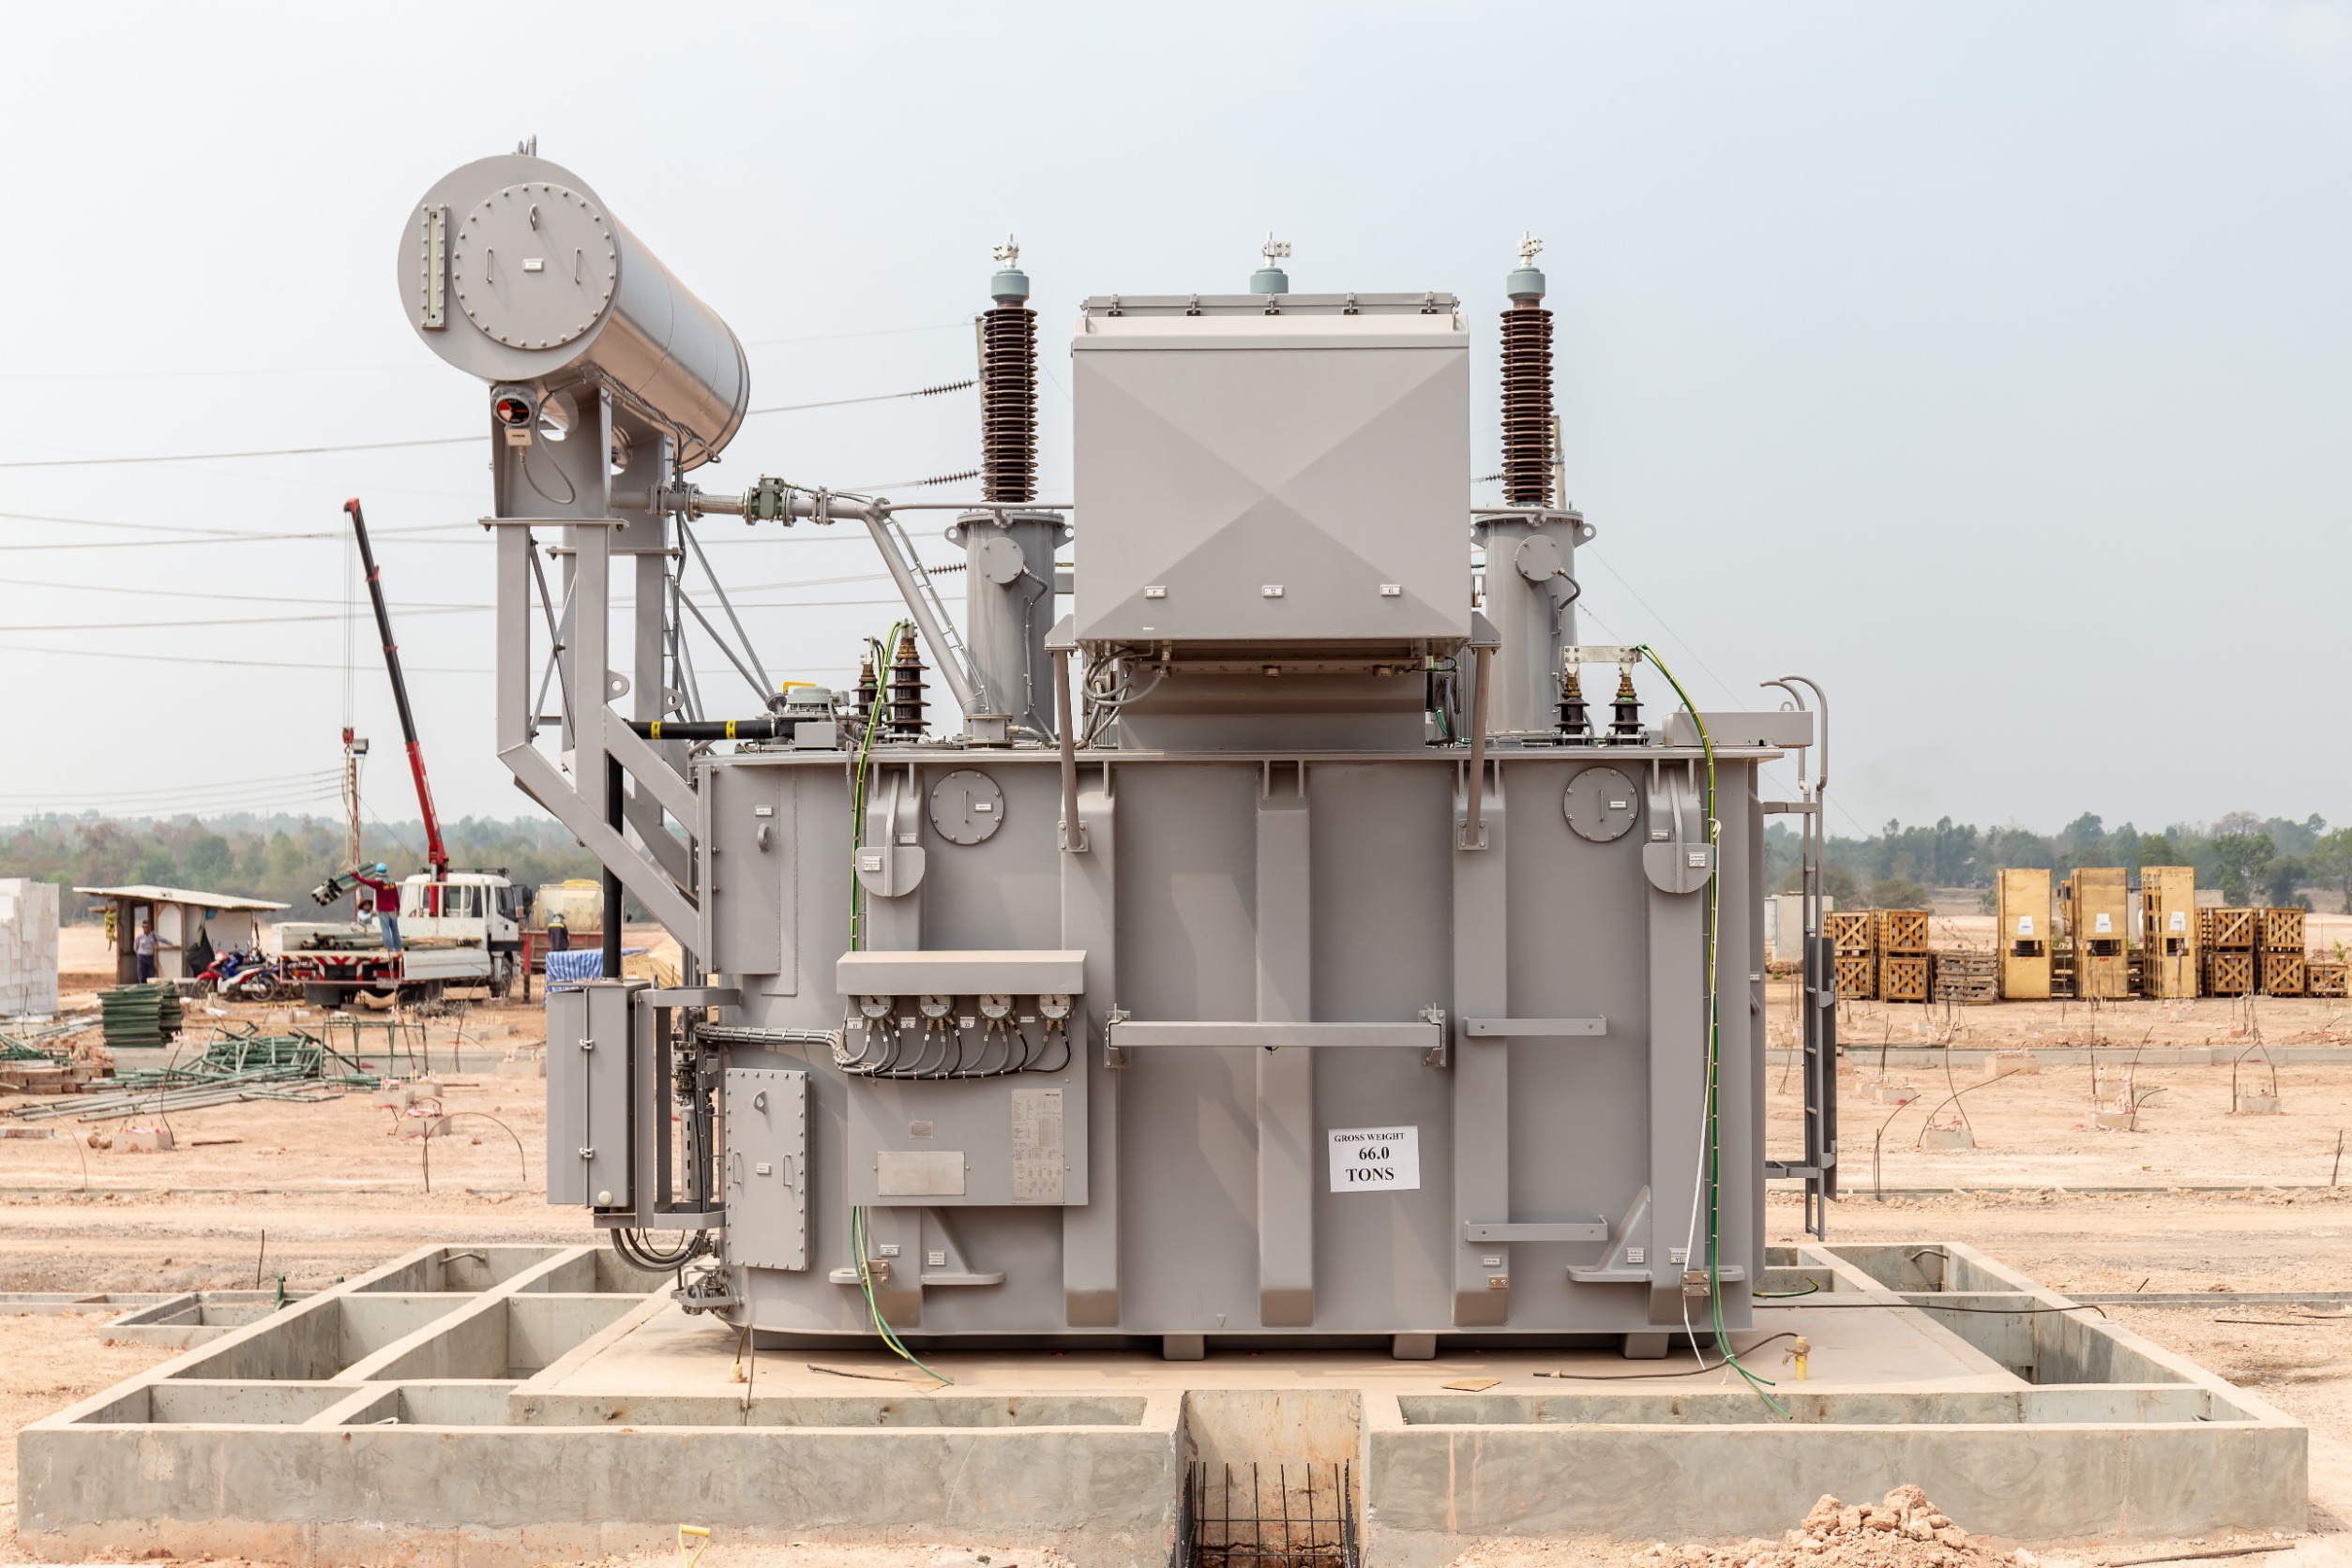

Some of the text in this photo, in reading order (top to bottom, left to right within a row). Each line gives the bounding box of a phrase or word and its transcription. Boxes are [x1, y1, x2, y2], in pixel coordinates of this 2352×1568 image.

[1334, 1132, 1406, 1142] GROSS WEIGHT
[1359, 1146, 1390, 1161] 66.0
[1346, 1167, 1395, 1183] TONS
